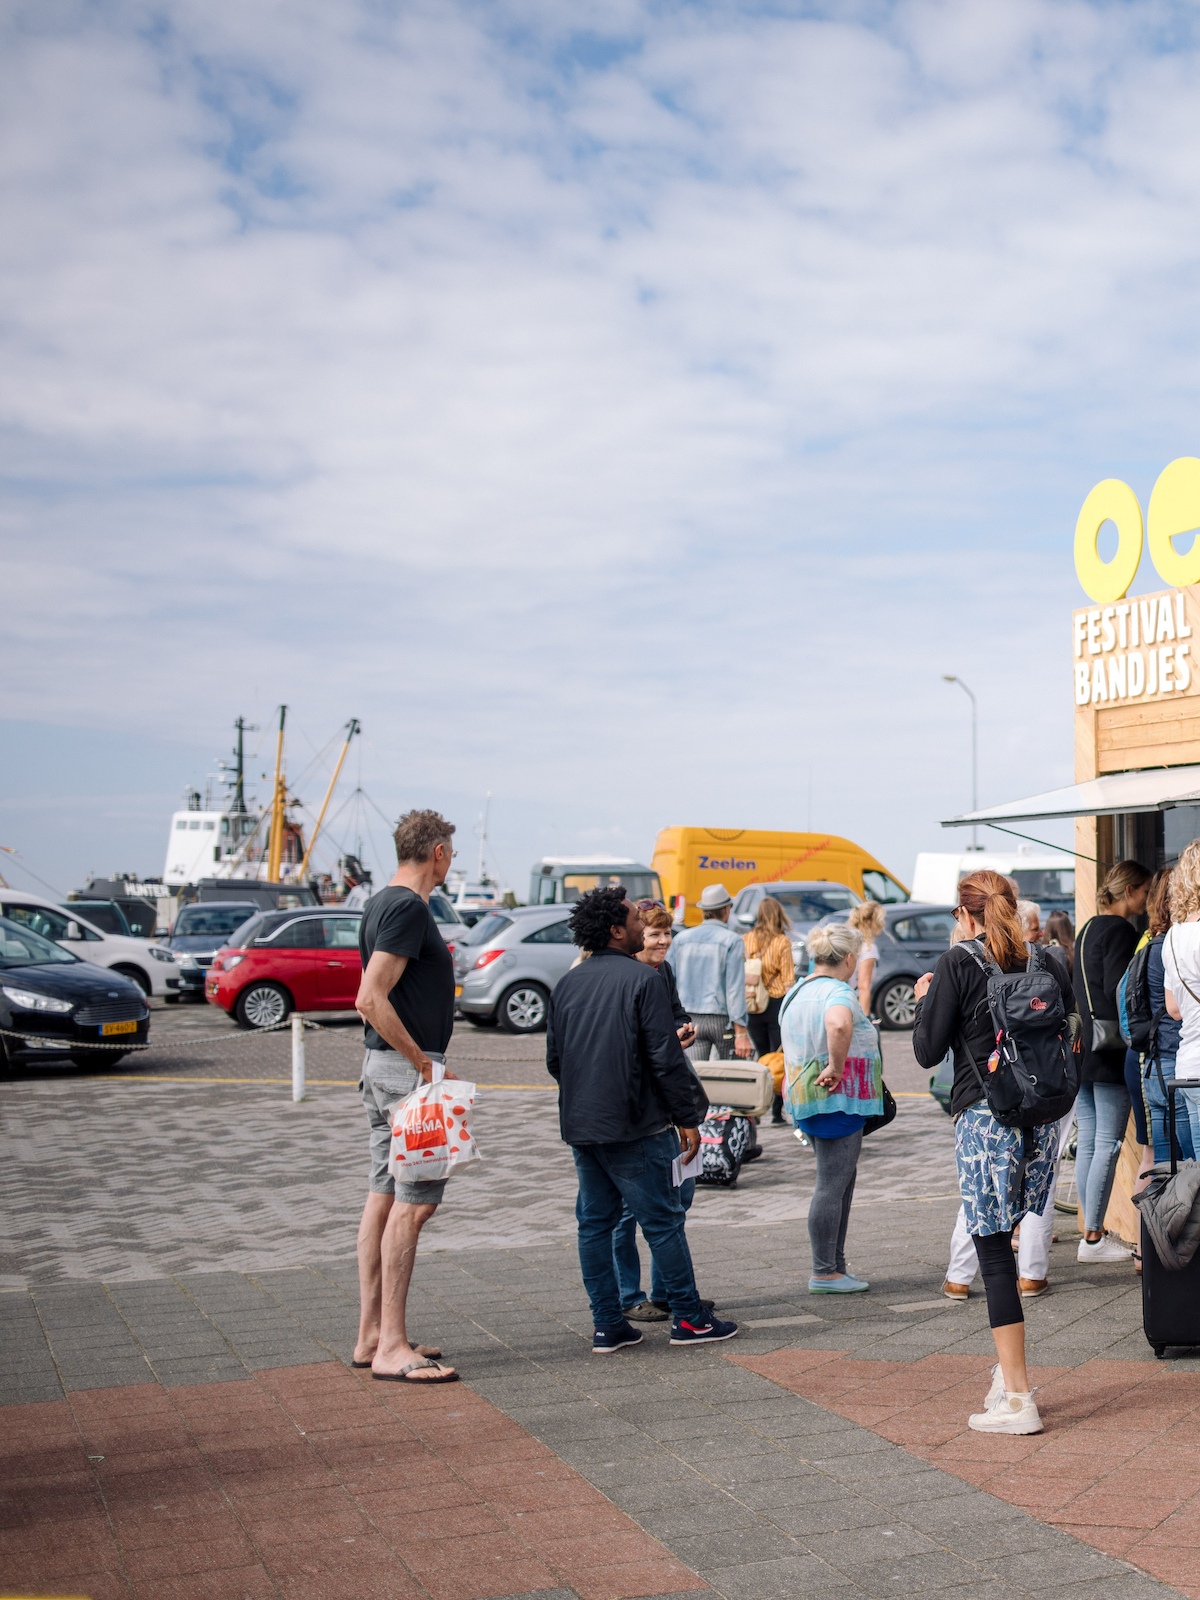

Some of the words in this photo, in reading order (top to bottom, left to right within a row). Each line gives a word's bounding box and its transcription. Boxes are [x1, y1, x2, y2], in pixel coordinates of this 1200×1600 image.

[1075, 593, 1192, 658] FESTIVAL
[1075, 644, 1191, 706] BANDJES
[698, 855, 756, 871] Zeelen
[124, 881, 171, 898] HUNTER
[406, 1118, 444, 1135] HEMA
